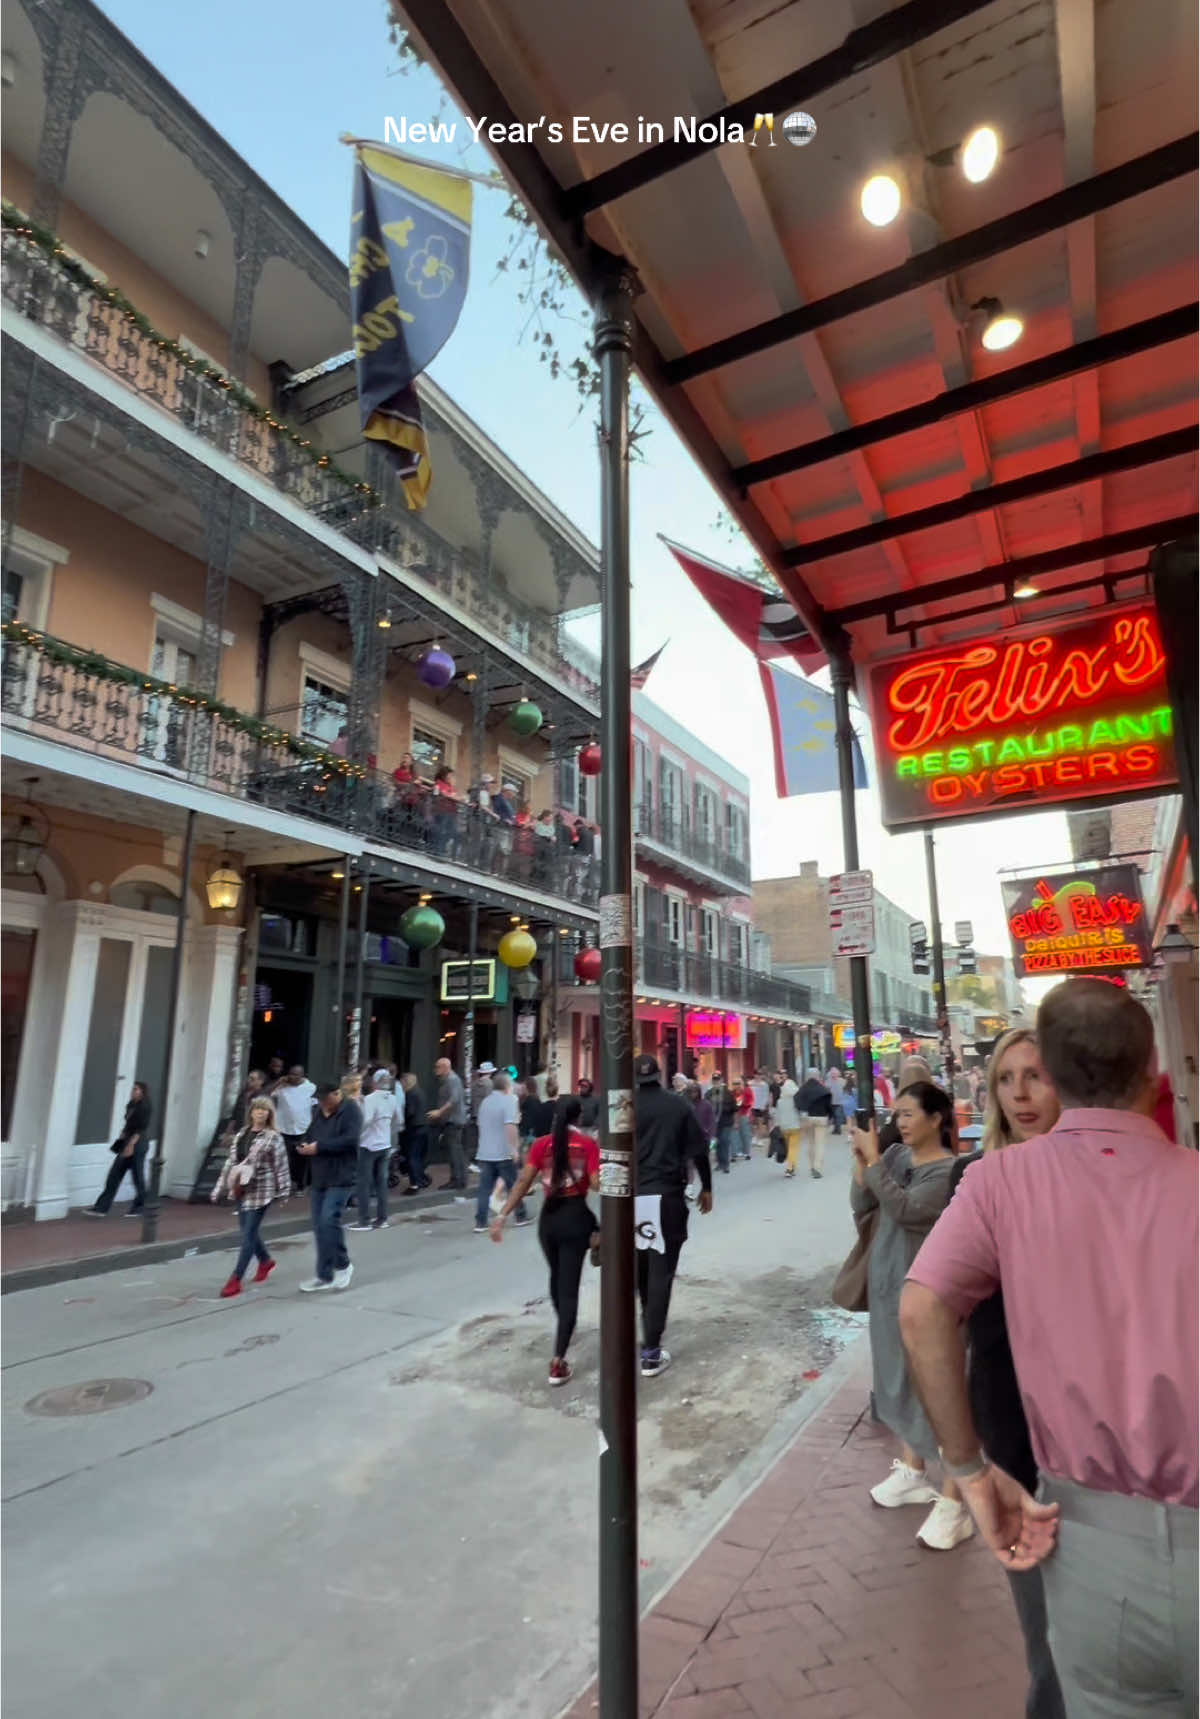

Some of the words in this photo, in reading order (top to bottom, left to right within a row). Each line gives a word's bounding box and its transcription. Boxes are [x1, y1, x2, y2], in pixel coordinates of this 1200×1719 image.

[888, 616, 1167, 752] Felix's
[897, 705, 1174, 777] RESTAURANT
[930, 744, 1157, 802] OYSTERS
[1010, 903, 1063, 939] BIG
[1069, 893, 1142, 930] EASY
[1024, 952, 1060, 971] PIZZA
